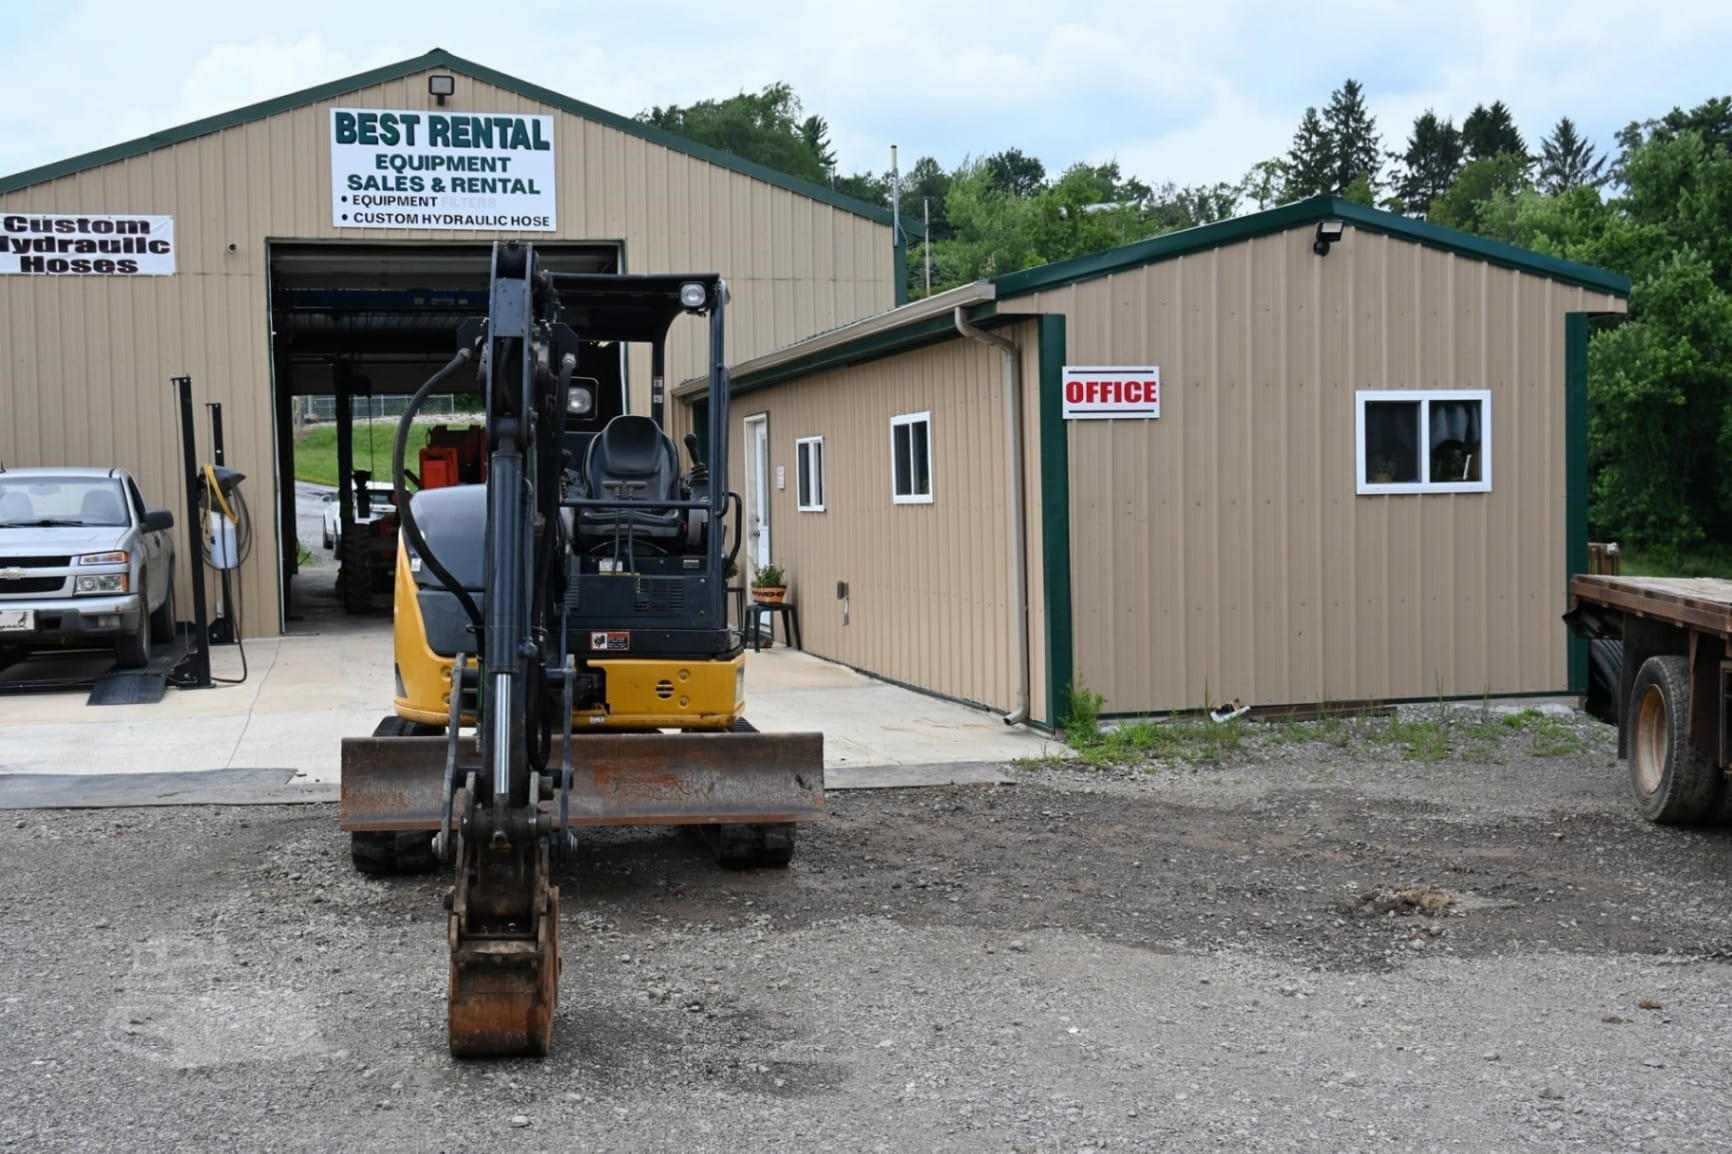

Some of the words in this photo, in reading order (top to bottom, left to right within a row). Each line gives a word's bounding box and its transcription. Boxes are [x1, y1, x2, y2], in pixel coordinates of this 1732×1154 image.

[335, 111, 421, 146] BEST
[428, 115, 551, 151] RENTAL
[375, 154, 511, 174] EQUIPMENT
[347, 174, 425, 193] SALES
[431, 177, 446, 193] &
[451, 177, 541, 195] RENTAL
[352, 195, 438, 209] EQUIPMENT
[441, 197, 497, 209] FILTERS
[3, 215, 151, 234] Custom
[353, 212, 419, 225] CUSTOM
[422, 214, 508, 227] HYDRAULIC
[511, 216, 550, 227] HOSE
[20, 256, 139, 273] Hoses
[1066, 381, 1157, 404] OFFICE
